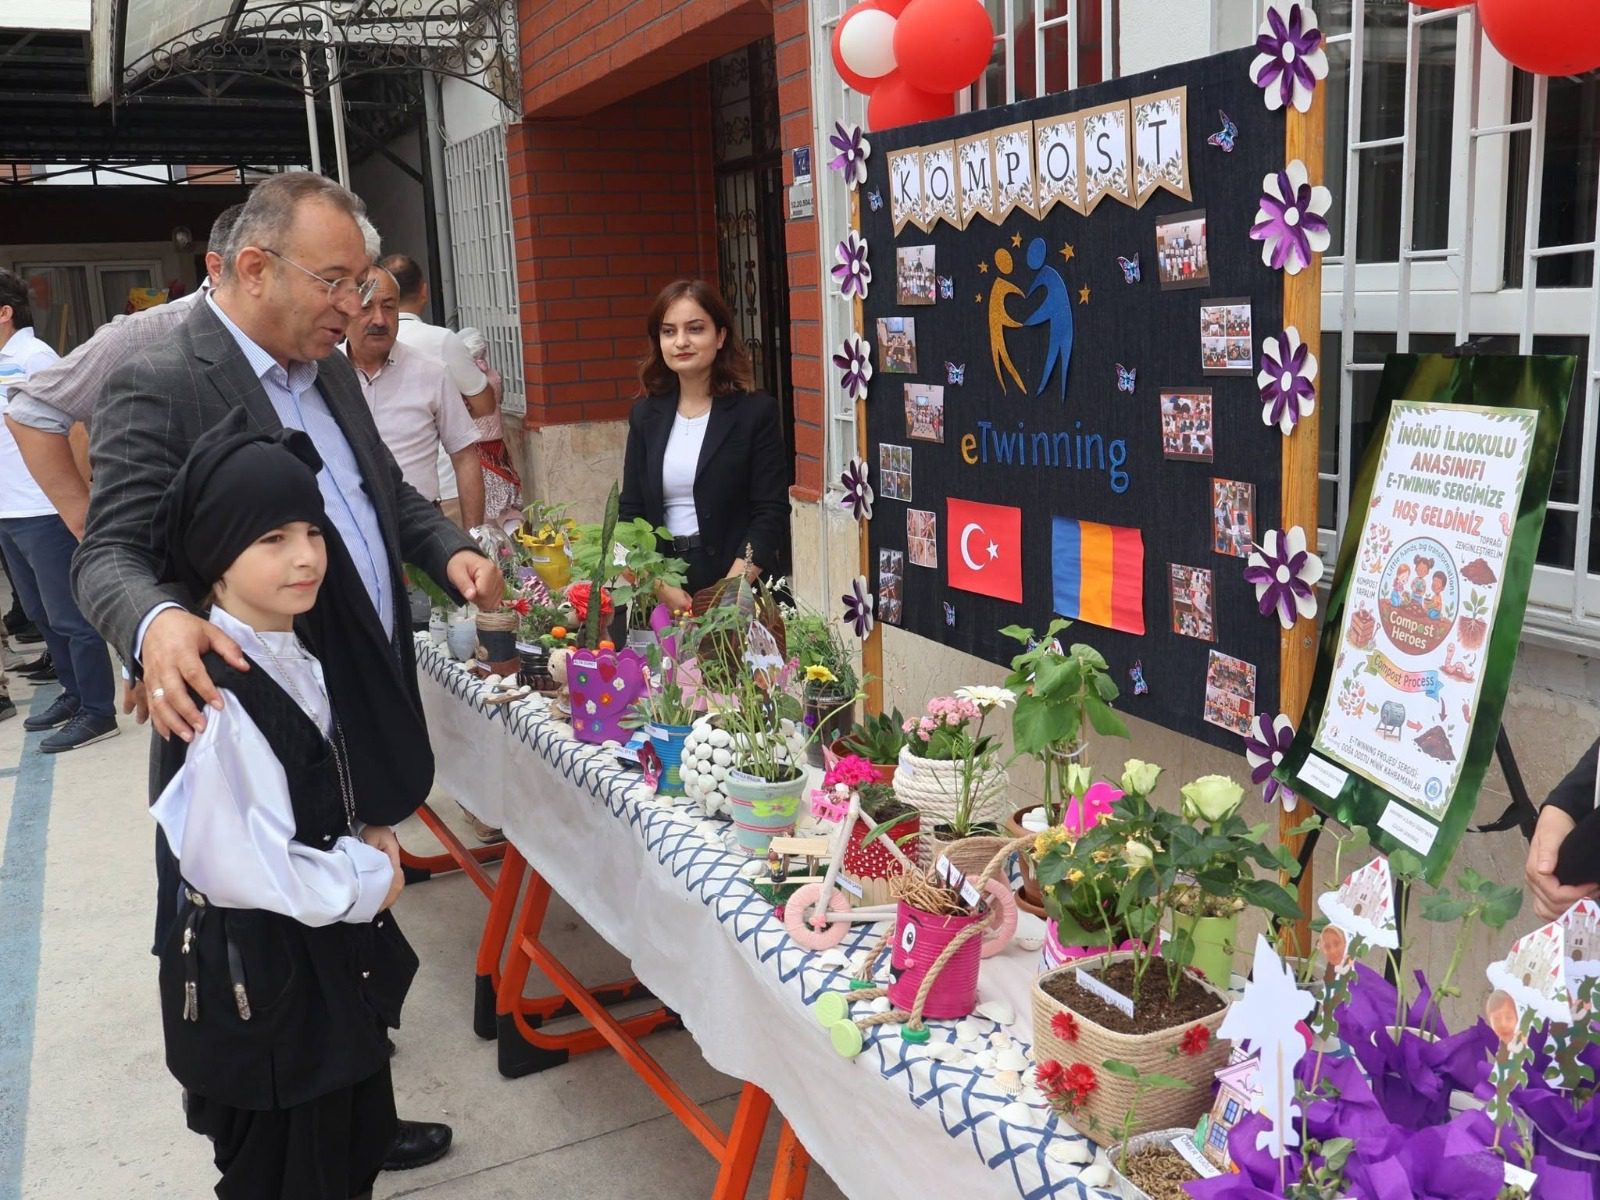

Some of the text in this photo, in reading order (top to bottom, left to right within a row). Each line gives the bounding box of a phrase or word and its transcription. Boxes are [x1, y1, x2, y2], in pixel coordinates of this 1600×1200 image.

[900, 119, 1168, 203] KOMPOST
[1397, 421, 1517, 459] İNÖNÜ İLKOKULU
[961, 420, 1130, 494] eTwinning
[1410, 451, 1486, 481] ANASINIFI
[1442, 482, 1505, 509] SERGİMİZE
[1392, 500, 1484, 537] HOŞ GELDİNİZ
[1390, 611, 1435, 637] Compost
[1391, 626, 1427, 649] Heroes
[1374, 655, 1434, 688] Compost Process
